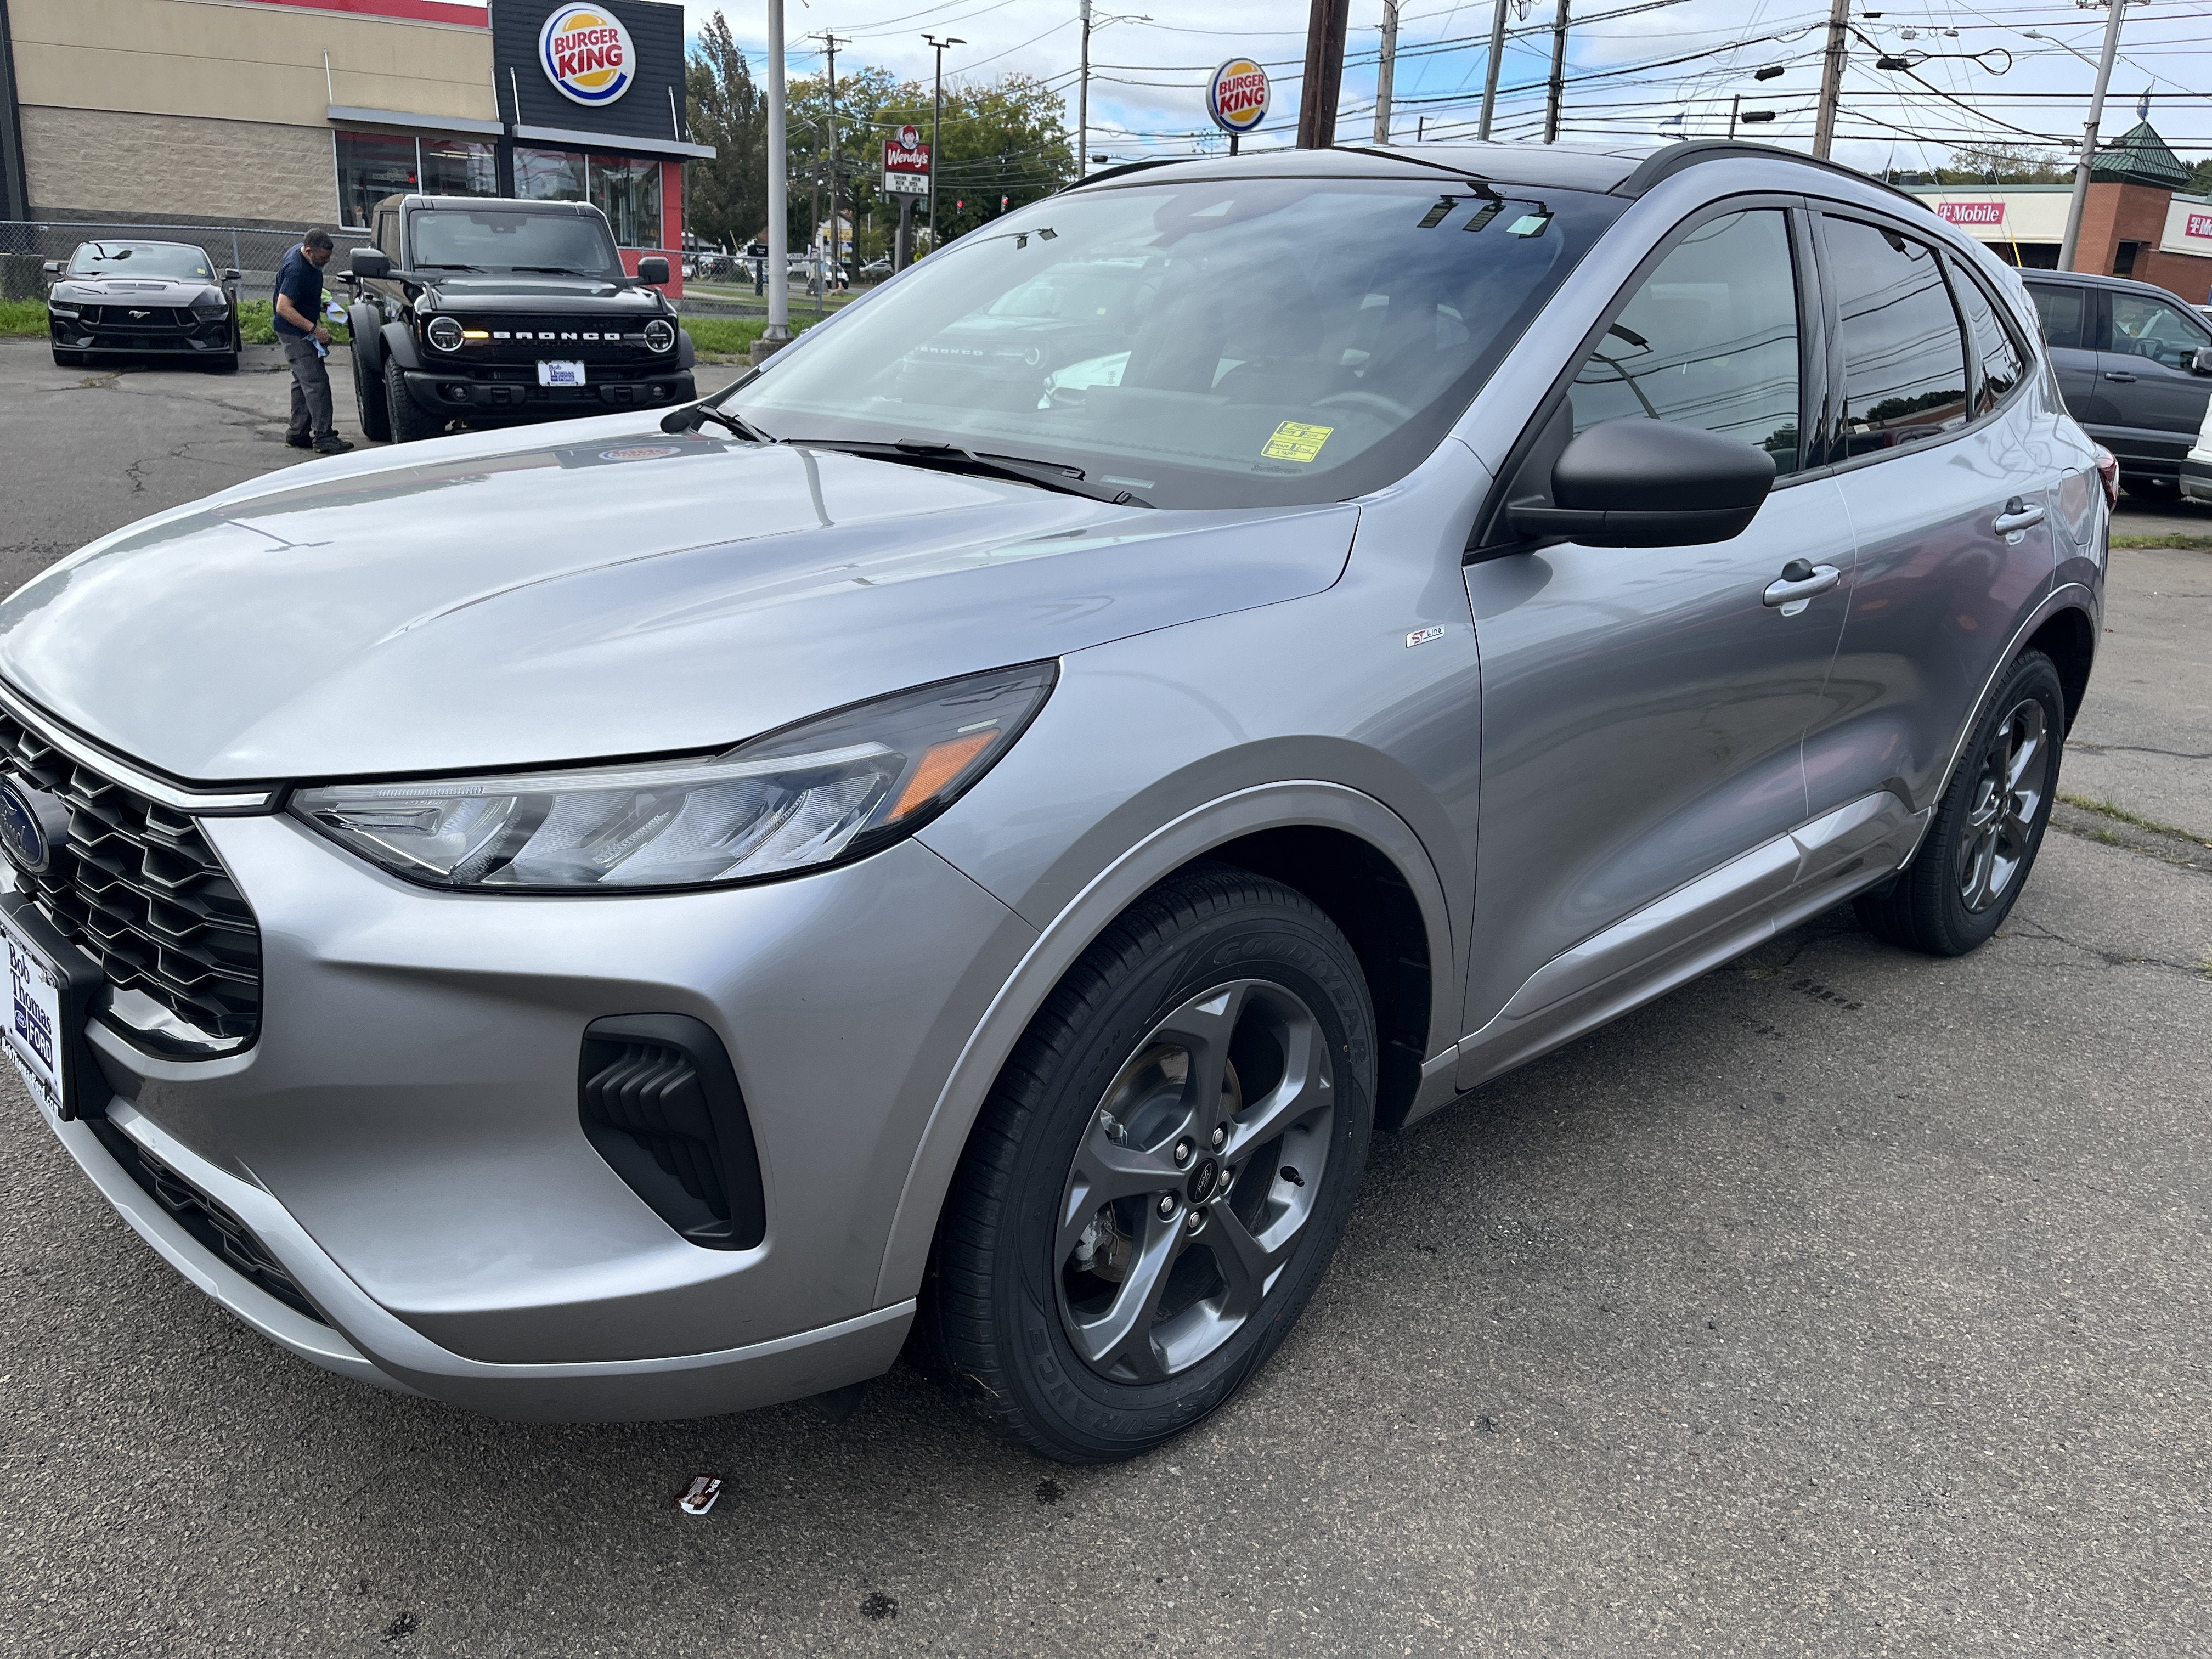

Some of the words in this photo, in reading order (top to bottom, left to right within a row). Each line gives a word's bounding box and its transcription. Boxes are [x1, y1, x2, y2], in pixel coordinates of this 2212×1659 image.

[555, 29, 619, 54] BURGER
[558, 44, 623, 78] KING
[1219, 74, 1264, 95] BURGER
[1220, 87, 1265, 114] KING
[888, 149, 928, 168] Wendy's
[493, 331, 620, 340] BRONCO
[1412, 630, 1425, 645] ST
[1427, 628, 1442, 636] Line
[8, 940, 30, 984] Bob
[10, 967, 52, 1036] Thomas
[1214, 937, 1369, 1063] GOODYEAR
[29, 1020, 52, 1064] FORD
[1029, 1327, 1225, 1435] ASSURANCE
